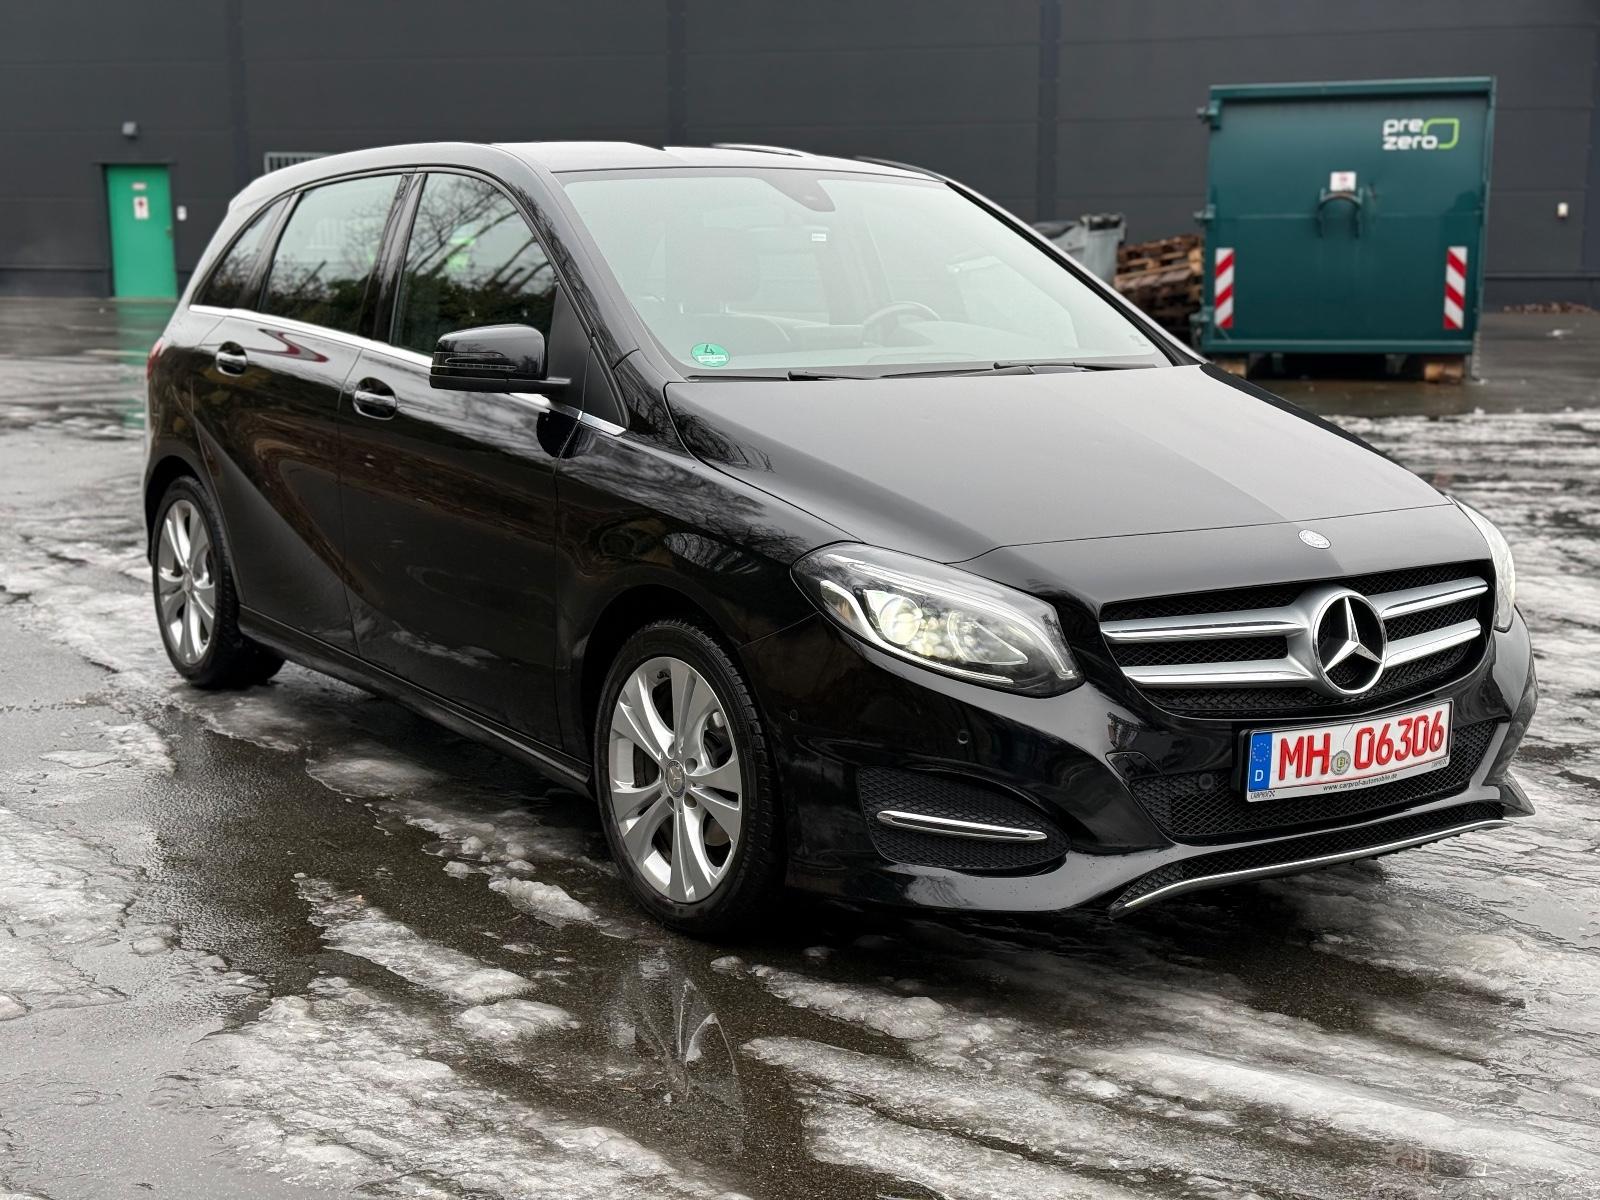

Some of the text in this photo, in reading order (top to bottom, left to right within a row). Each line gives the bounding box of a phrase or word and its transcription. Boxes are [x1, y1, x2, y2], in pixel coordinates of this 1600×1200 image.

[1383, 118, 1424, 135] pre
[1382, 135, 1438, 150] zero
[704, 344, 715, 355] 4
[1278, 711, 1444, 780] MH 06306
[1254, 769, 1264, 782] D
